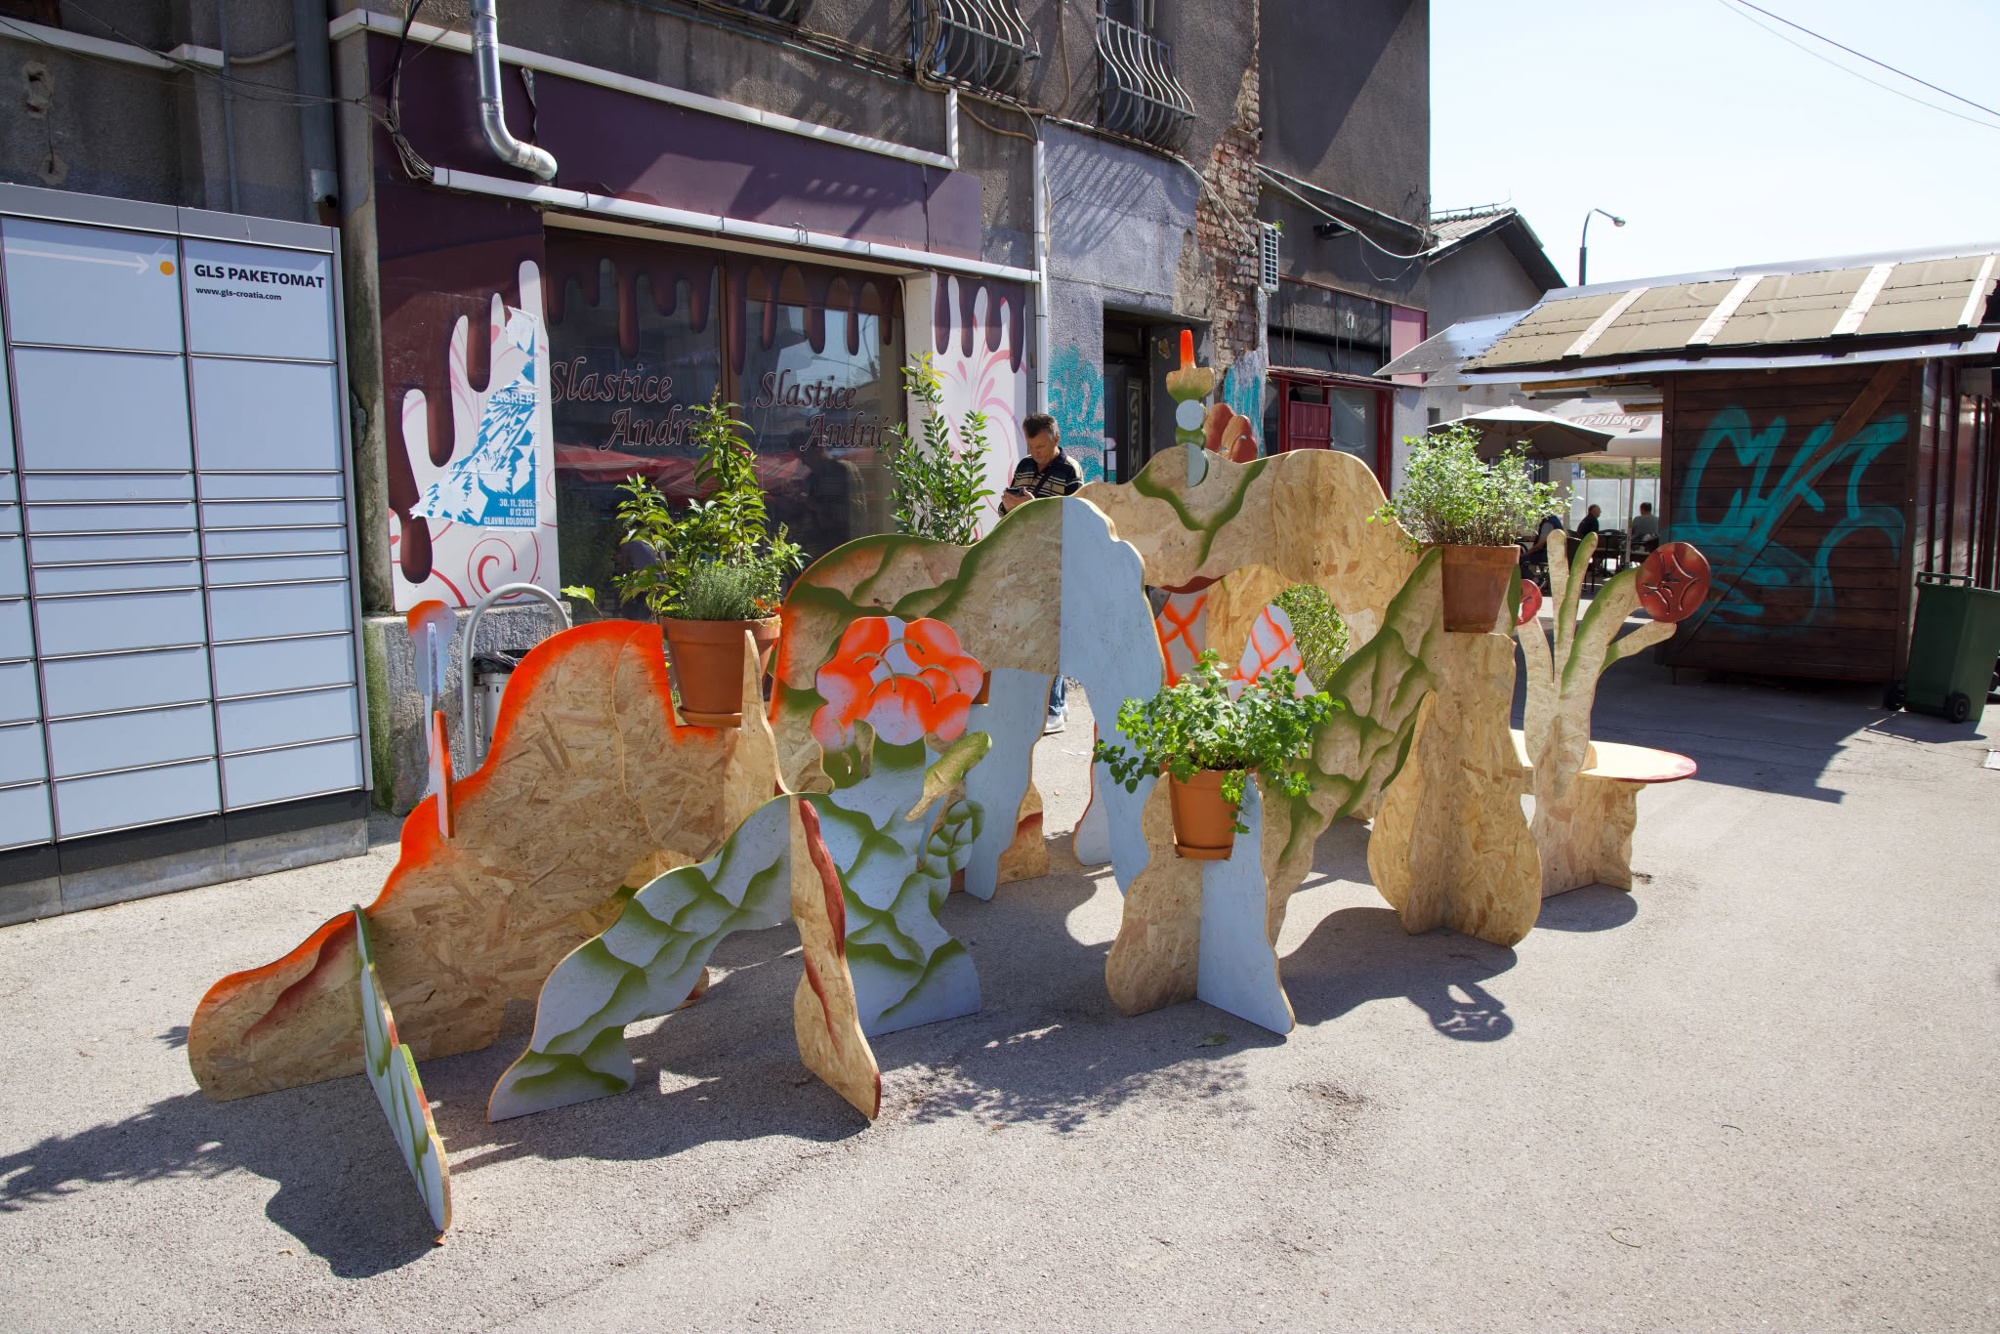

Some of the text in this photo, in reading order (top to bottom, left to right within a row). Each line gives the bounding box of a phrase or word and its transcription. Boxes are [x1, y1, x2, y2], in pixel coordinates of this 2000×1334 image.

[194, 264, 325, 288] GLS PAKETOMAT
[195, 287, 282, 300] www.gls-croatia.com
[550, 356, 673, 403] Slastice
[755, 368, 857, 409] Slastice
[599, 404, 711, 451] Andri
[499, 498, 510, 507] 30.
[483, 516, 535, 526] GLAVNI KOLODVOR
[510, 508, 515, 516] U
[522, 508, 535, 517] SATI
